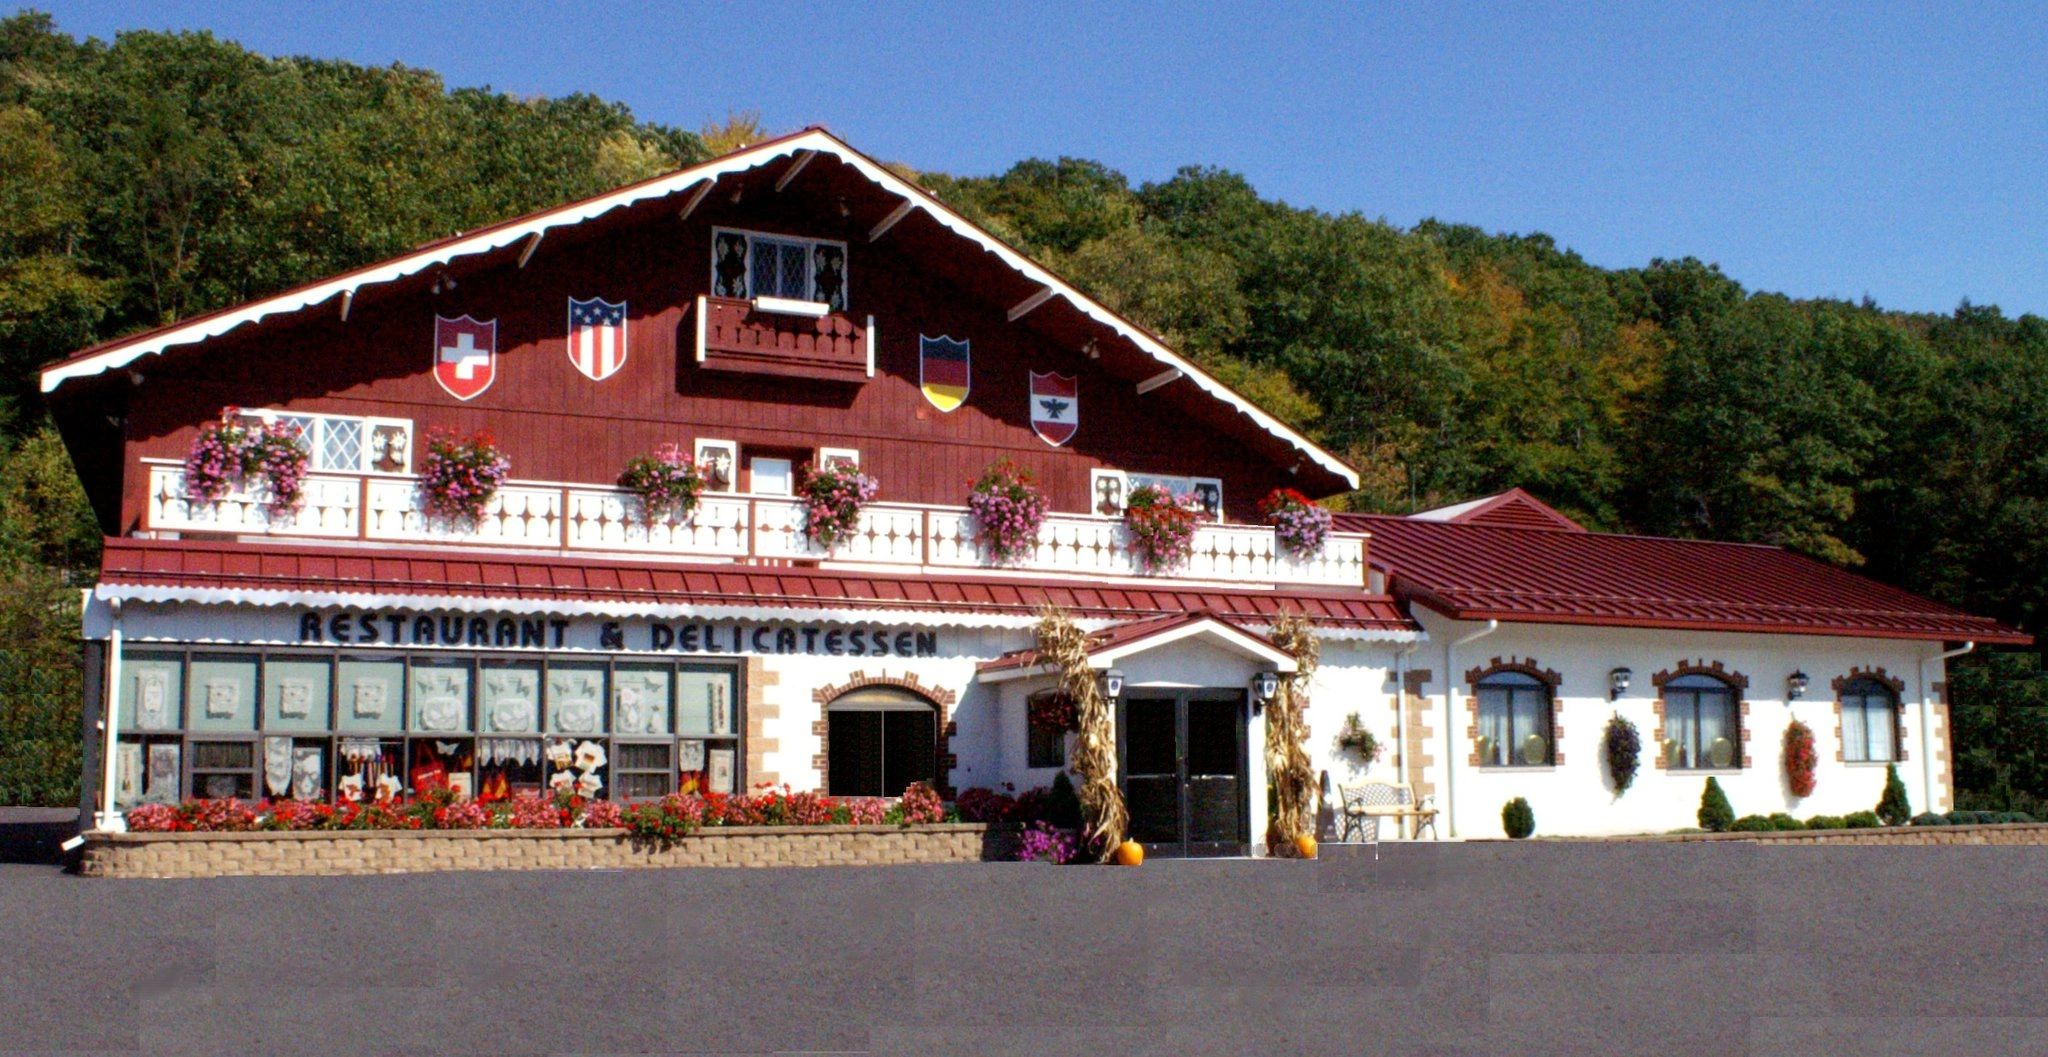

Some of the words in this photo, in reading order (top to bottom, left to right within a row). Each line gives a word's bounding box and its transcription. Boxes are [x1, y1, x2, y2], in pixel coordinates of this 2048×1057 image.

[300, 611, 570, 648] RESTAURANT
[601, 622, 624, 650] &
[651, 623, 937, 657] DELICATESSEN
